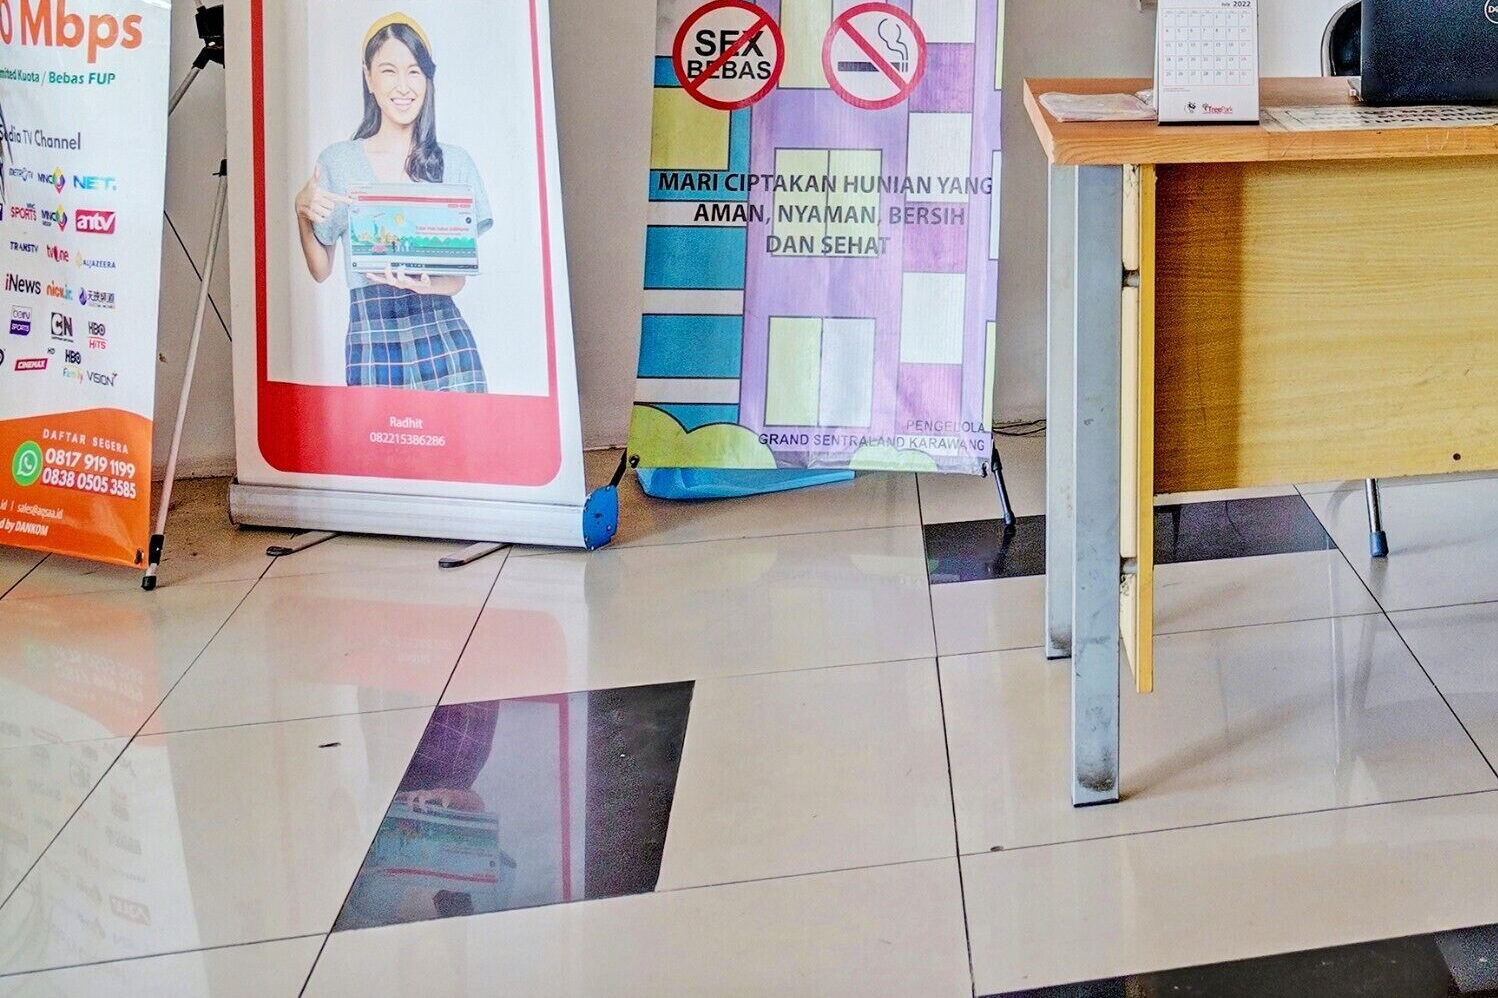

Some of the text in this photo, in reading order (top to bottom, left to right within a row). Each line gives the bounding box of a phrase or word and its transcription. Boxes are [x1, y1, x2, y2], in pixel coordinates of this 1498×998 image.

[695, 29, 764, 57] SEX
[17, 70, 40, 82] Kuota
[49, 71, 84, 84] Bebas
[88, 72, 116, 85] FUP
[686, 60, 772, 80] BEBAS
[23, 130, 32, 145] TV
[34, 129, 80, 150] Channel
[658, 173, 994, 195] MARI CIPTAKAN HUNIAN YANG
[11, 206, 37, 221] SPORTS
[694, 203, 965, 227] AMAN, NYAMAN, BERSIH
[766, 235, 890, 255] DAN SEHAT
[5, 273, 42, 295] iNews
[88, 321, 106, 336] HBO
[89, 339, 107, 350] HITS
[65, 349, 82, 365] HBO
[390, 416, 423, 430] Radhit
[906, 419, 986, 434] PENGELOLA
[43, 428, 129, 454] DAFTAR SEGERA
[369, 431, 446, 447] 082215386286
[758, 433, 986, 451] GRAND SENTRALAND KARAWANG
[45, 448, 136, 479] 0817 919 1199
[42, 467, 137, 500] 0838 0505 3585
[4, 518, 15, 533] by
[15, 520, 49, 536] DANKOM
